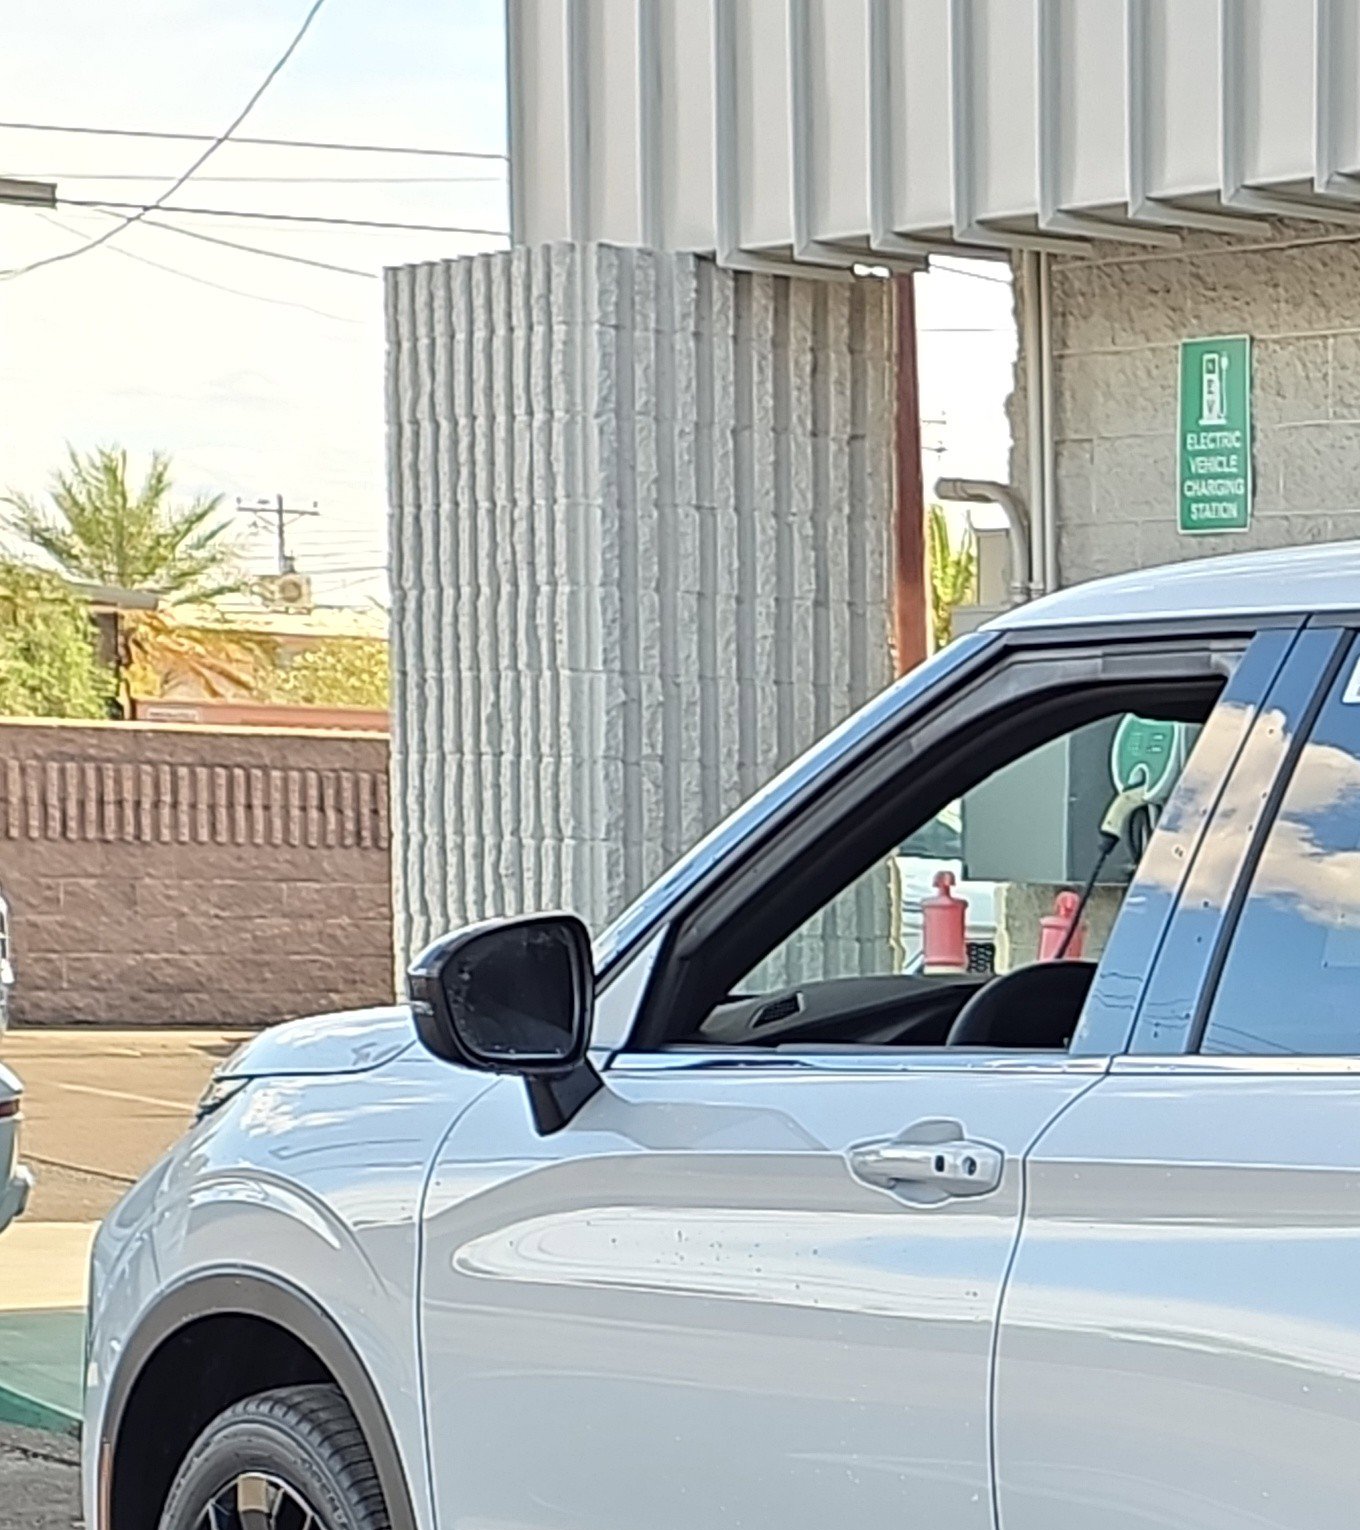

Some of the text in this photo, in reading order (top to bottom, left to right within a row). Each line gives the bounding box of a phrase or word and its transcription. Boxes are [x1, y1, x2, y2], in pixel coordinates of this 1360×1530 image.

[1186, 431, 1242, 450] ELECTRIC
[1189, 455, 1239, 474] VEHICLE
[1183, 479, 1245, 497] CHARGING
[1190, 502, 1238, 520] STATION
